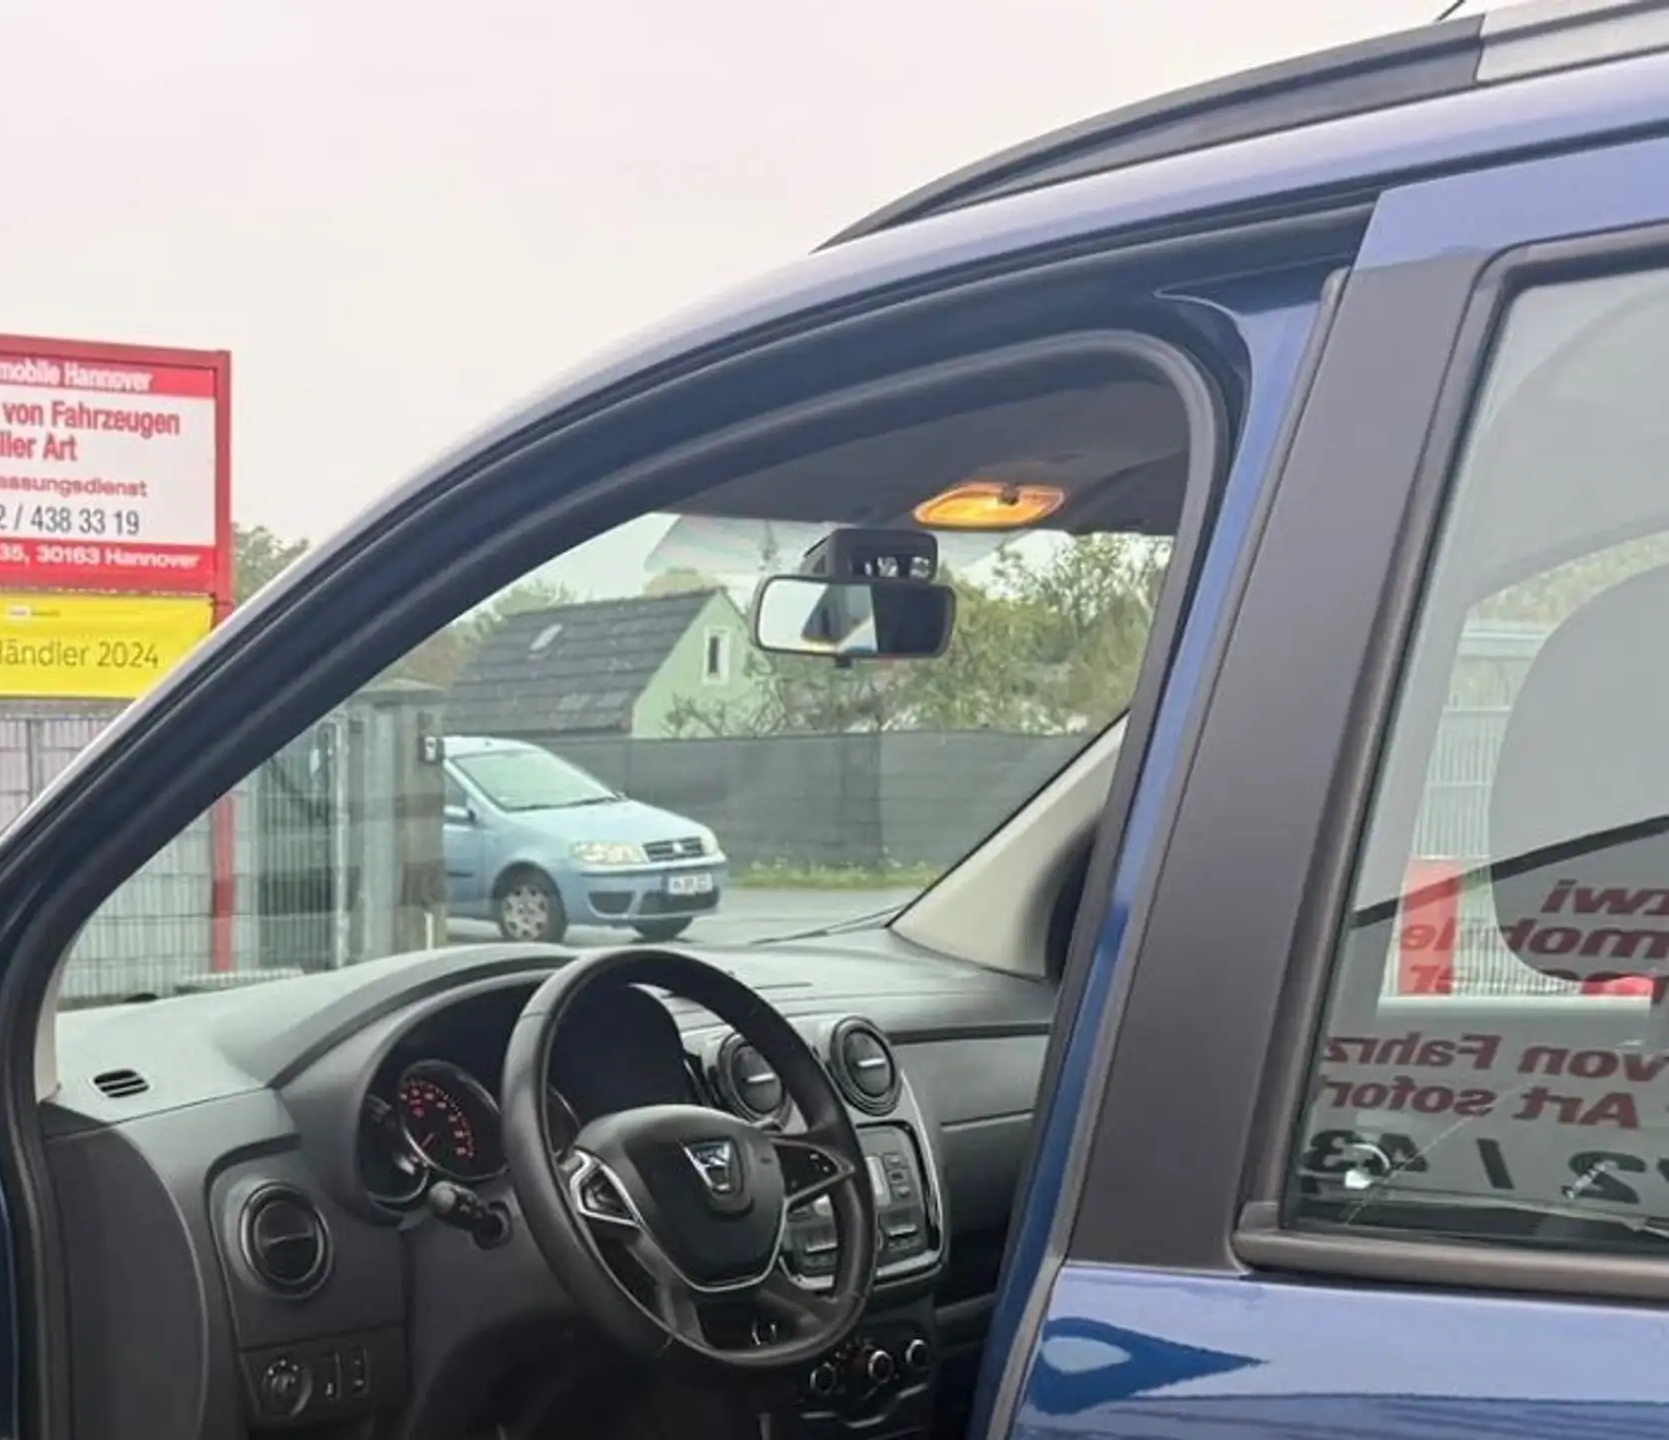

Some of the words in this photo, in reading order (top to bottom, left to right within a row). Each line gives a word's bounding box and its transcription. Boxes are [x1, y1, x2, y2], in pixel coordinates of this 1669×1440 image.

[64, 362, 153, 392] Hannover
[2, 402, 44, 426] von
[51, 400, 181, 439] Fahrzeugen
[42, 434, 78, 461] Art
[13, 504, 24, 529] /
[30, 508, 72, 534] 438
[78, 509, 106, 534] 33
[114, 511, 140, 536] 19
[36, 548, 100, 566] 30163
[105, 550, 201, 570] Hannover
[97, 640, 160, 669] 2024
